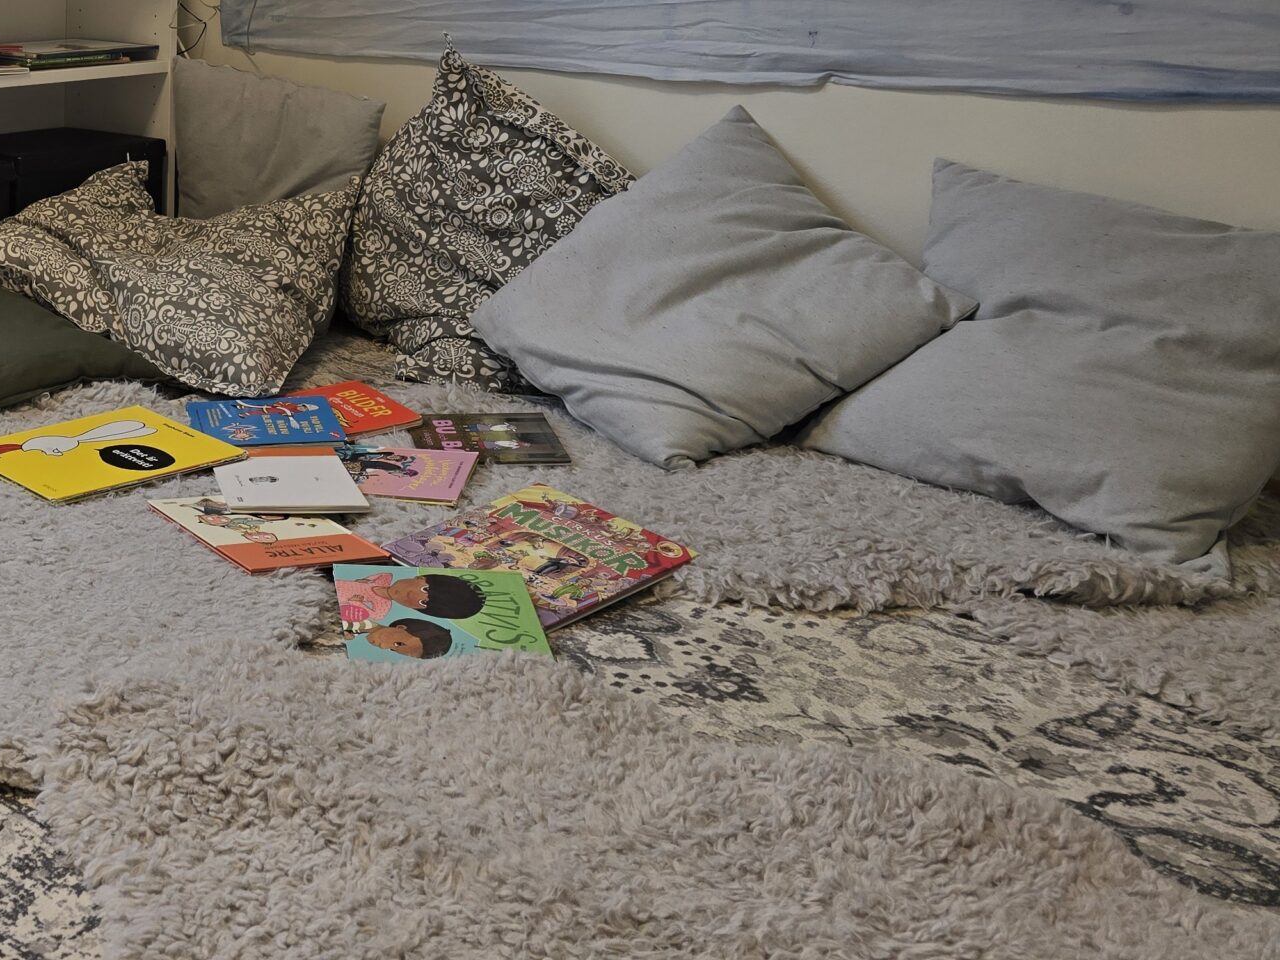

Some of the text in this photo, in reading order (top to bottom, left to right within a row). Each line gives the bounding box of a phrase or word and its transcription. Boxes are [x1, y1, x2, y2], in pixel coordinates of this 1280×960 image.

[336, 389, 393, 418] BILDER
[432, 419, 457, 434] BU
[112, 449, 153, 468] orättvist!
[130, 448, 148, 458] Det
[496, 502, 649, 577] MUSIKOR
[551, 516, 617, 547] CIRKUS
[302, 544, 344, 555] ALLA
